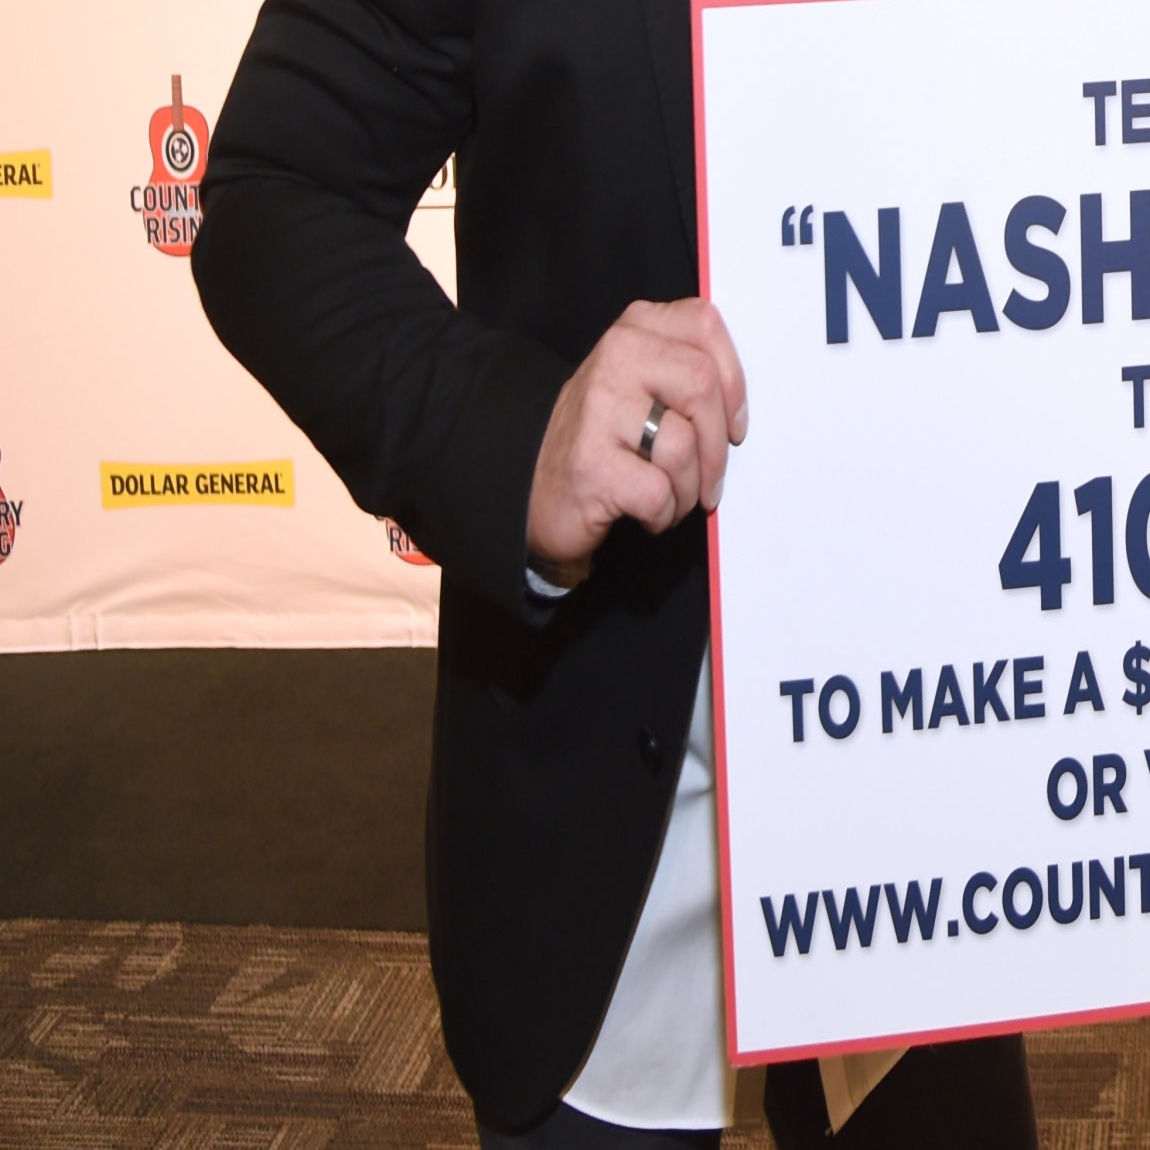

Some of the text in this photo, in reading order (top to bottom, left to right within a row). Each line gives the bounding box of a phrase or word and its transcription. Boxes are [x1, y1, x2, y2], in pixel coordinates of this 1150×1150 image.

[130, 184, 200, 212] COUNT
[147, 217, 203, 243] RISIN
[110, 474, 284, 495] DOLLAR GENERAL
[780, 675, 860, 742] TO
[881, 656, 1045, 734] MAKE
[1064, 651, 1105, 714] A
[1047, 754, 1128, 820] OR
